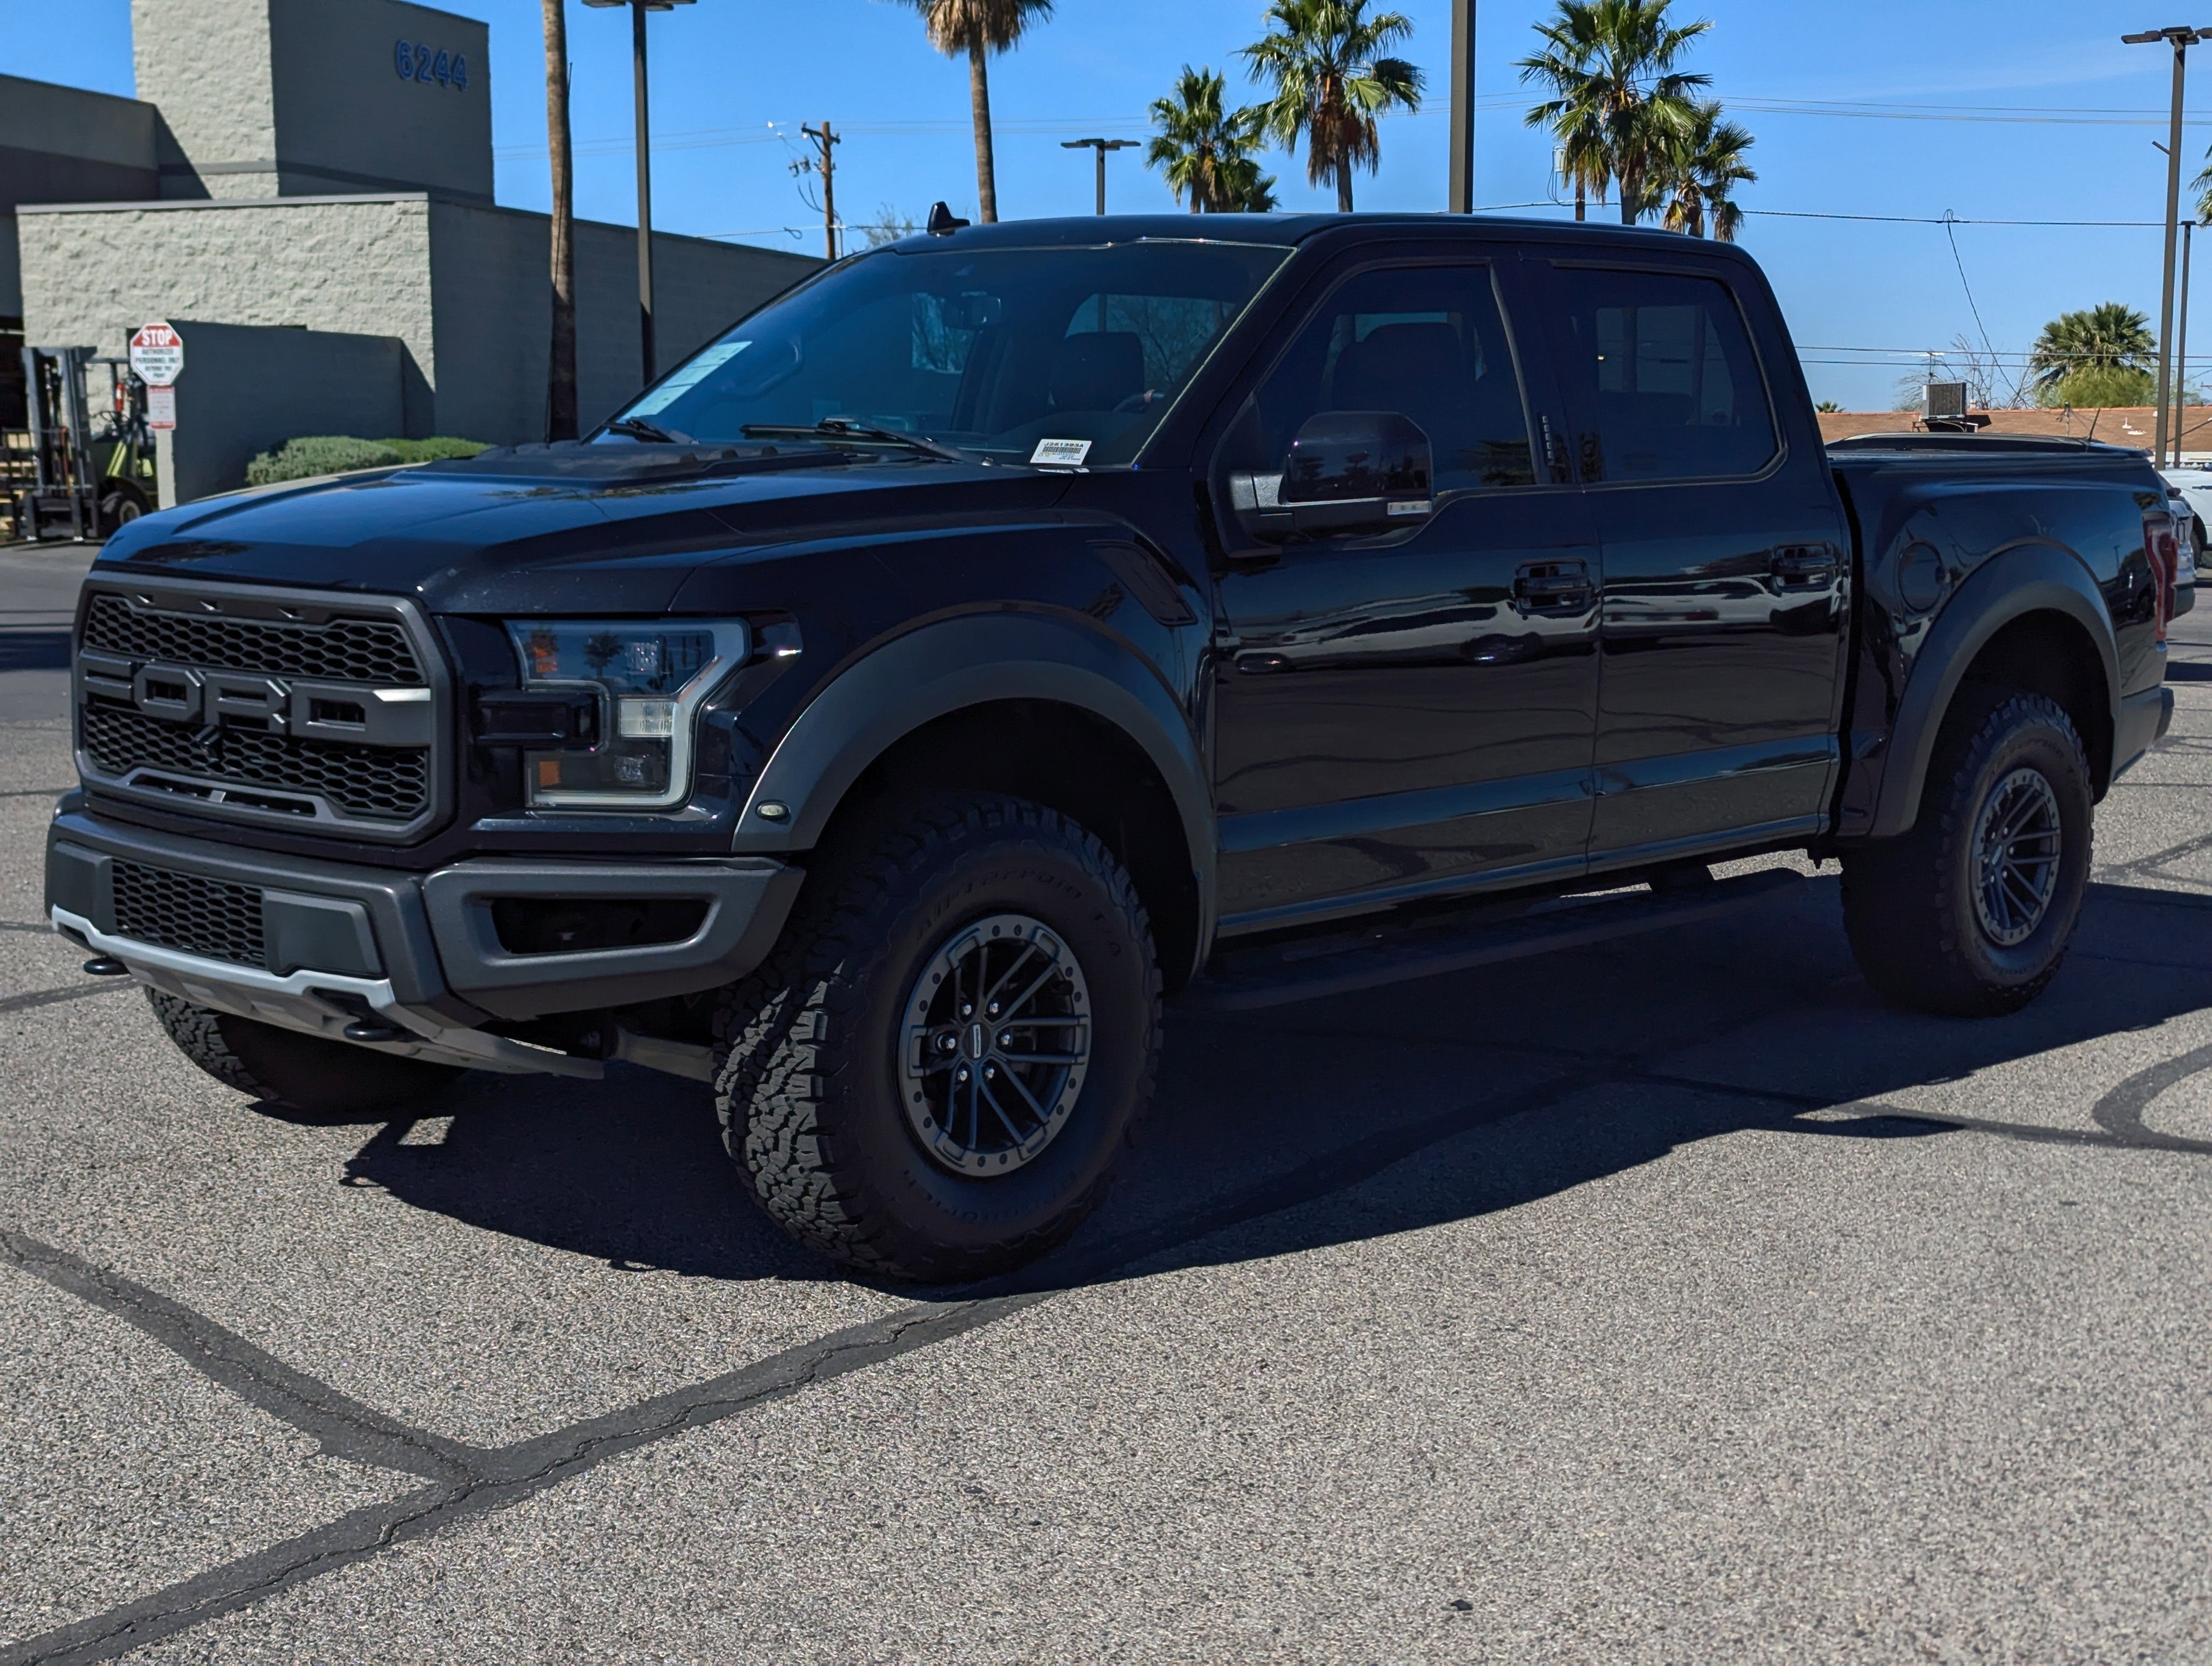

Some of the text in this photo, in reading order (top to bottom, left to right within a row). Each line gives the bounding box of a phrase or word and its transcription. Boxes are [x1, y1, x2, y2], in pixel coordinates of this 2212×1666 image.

[395, 40, 467, 92] 6244
[142, 330, 173, 345] STOP
[80, 650, 393, 744] FORD
